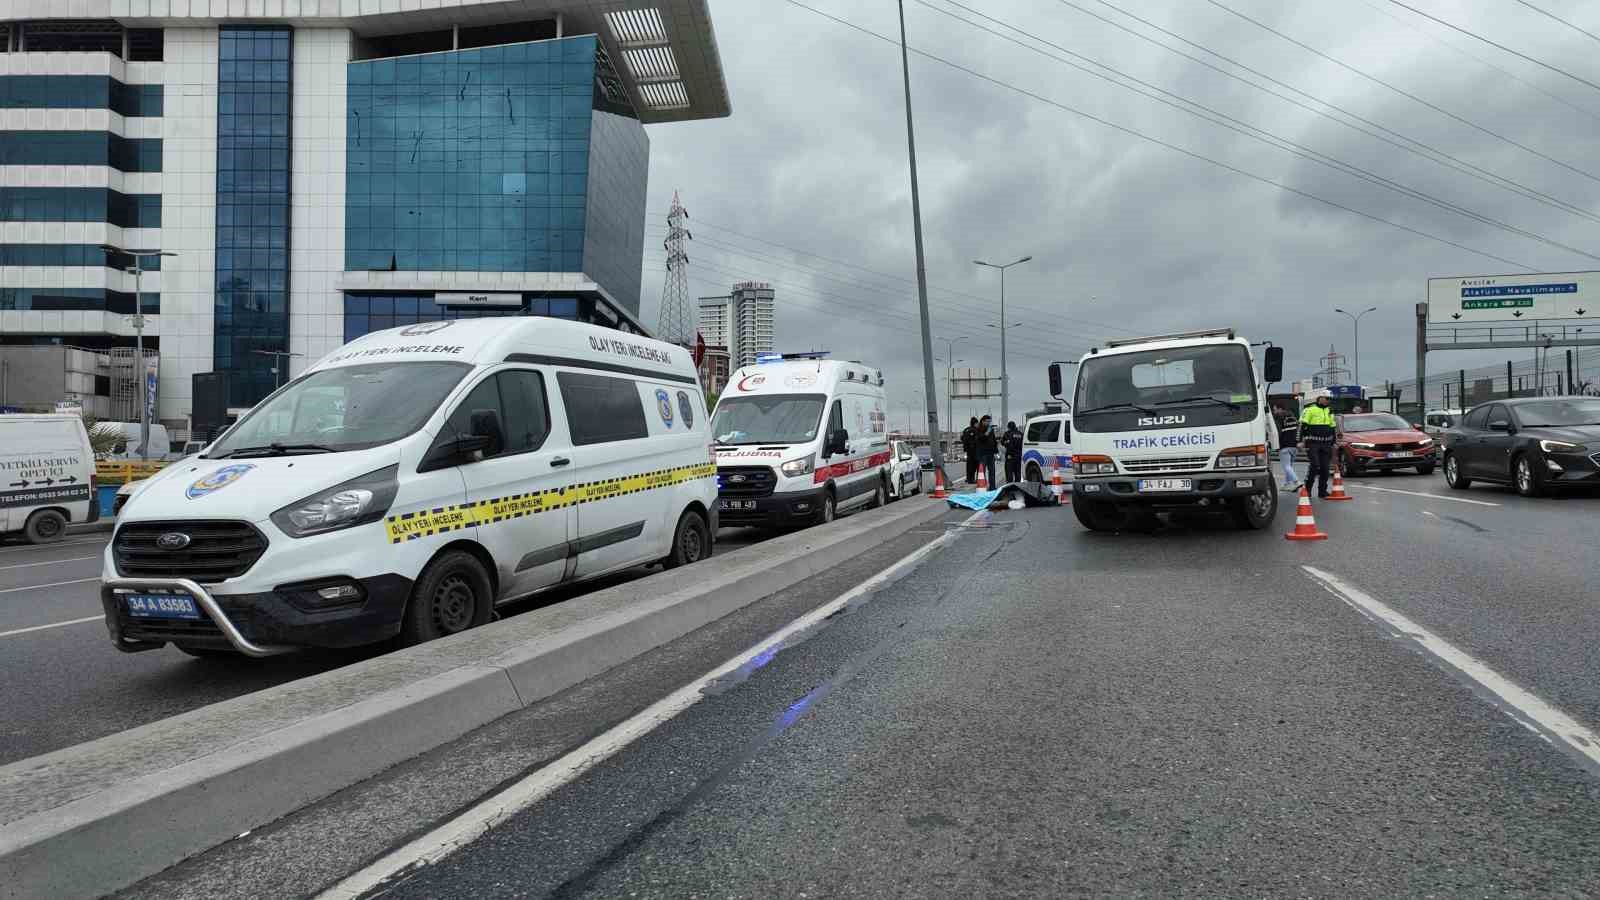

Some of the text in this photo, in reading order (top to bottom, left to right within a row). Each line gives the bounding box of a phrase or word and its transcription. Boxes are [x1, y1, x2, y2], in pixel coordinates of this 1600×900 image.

[1463, 288, 1501, 296] Atatürk
[589, 335, 610, 352] OLAY
[1138, 415, 1186, 426] ISUZU
[1113, 431, 1216, 449] TRAFİK ÇEKİCİSİ
[493, 497, 544, 515] OLAY YERİ İNCELEME
[392, 511, 464, 535] OLAY YERİ İNCELEME
[129, 597, 145, 609] 34
[147, 598, 157, 610] A
